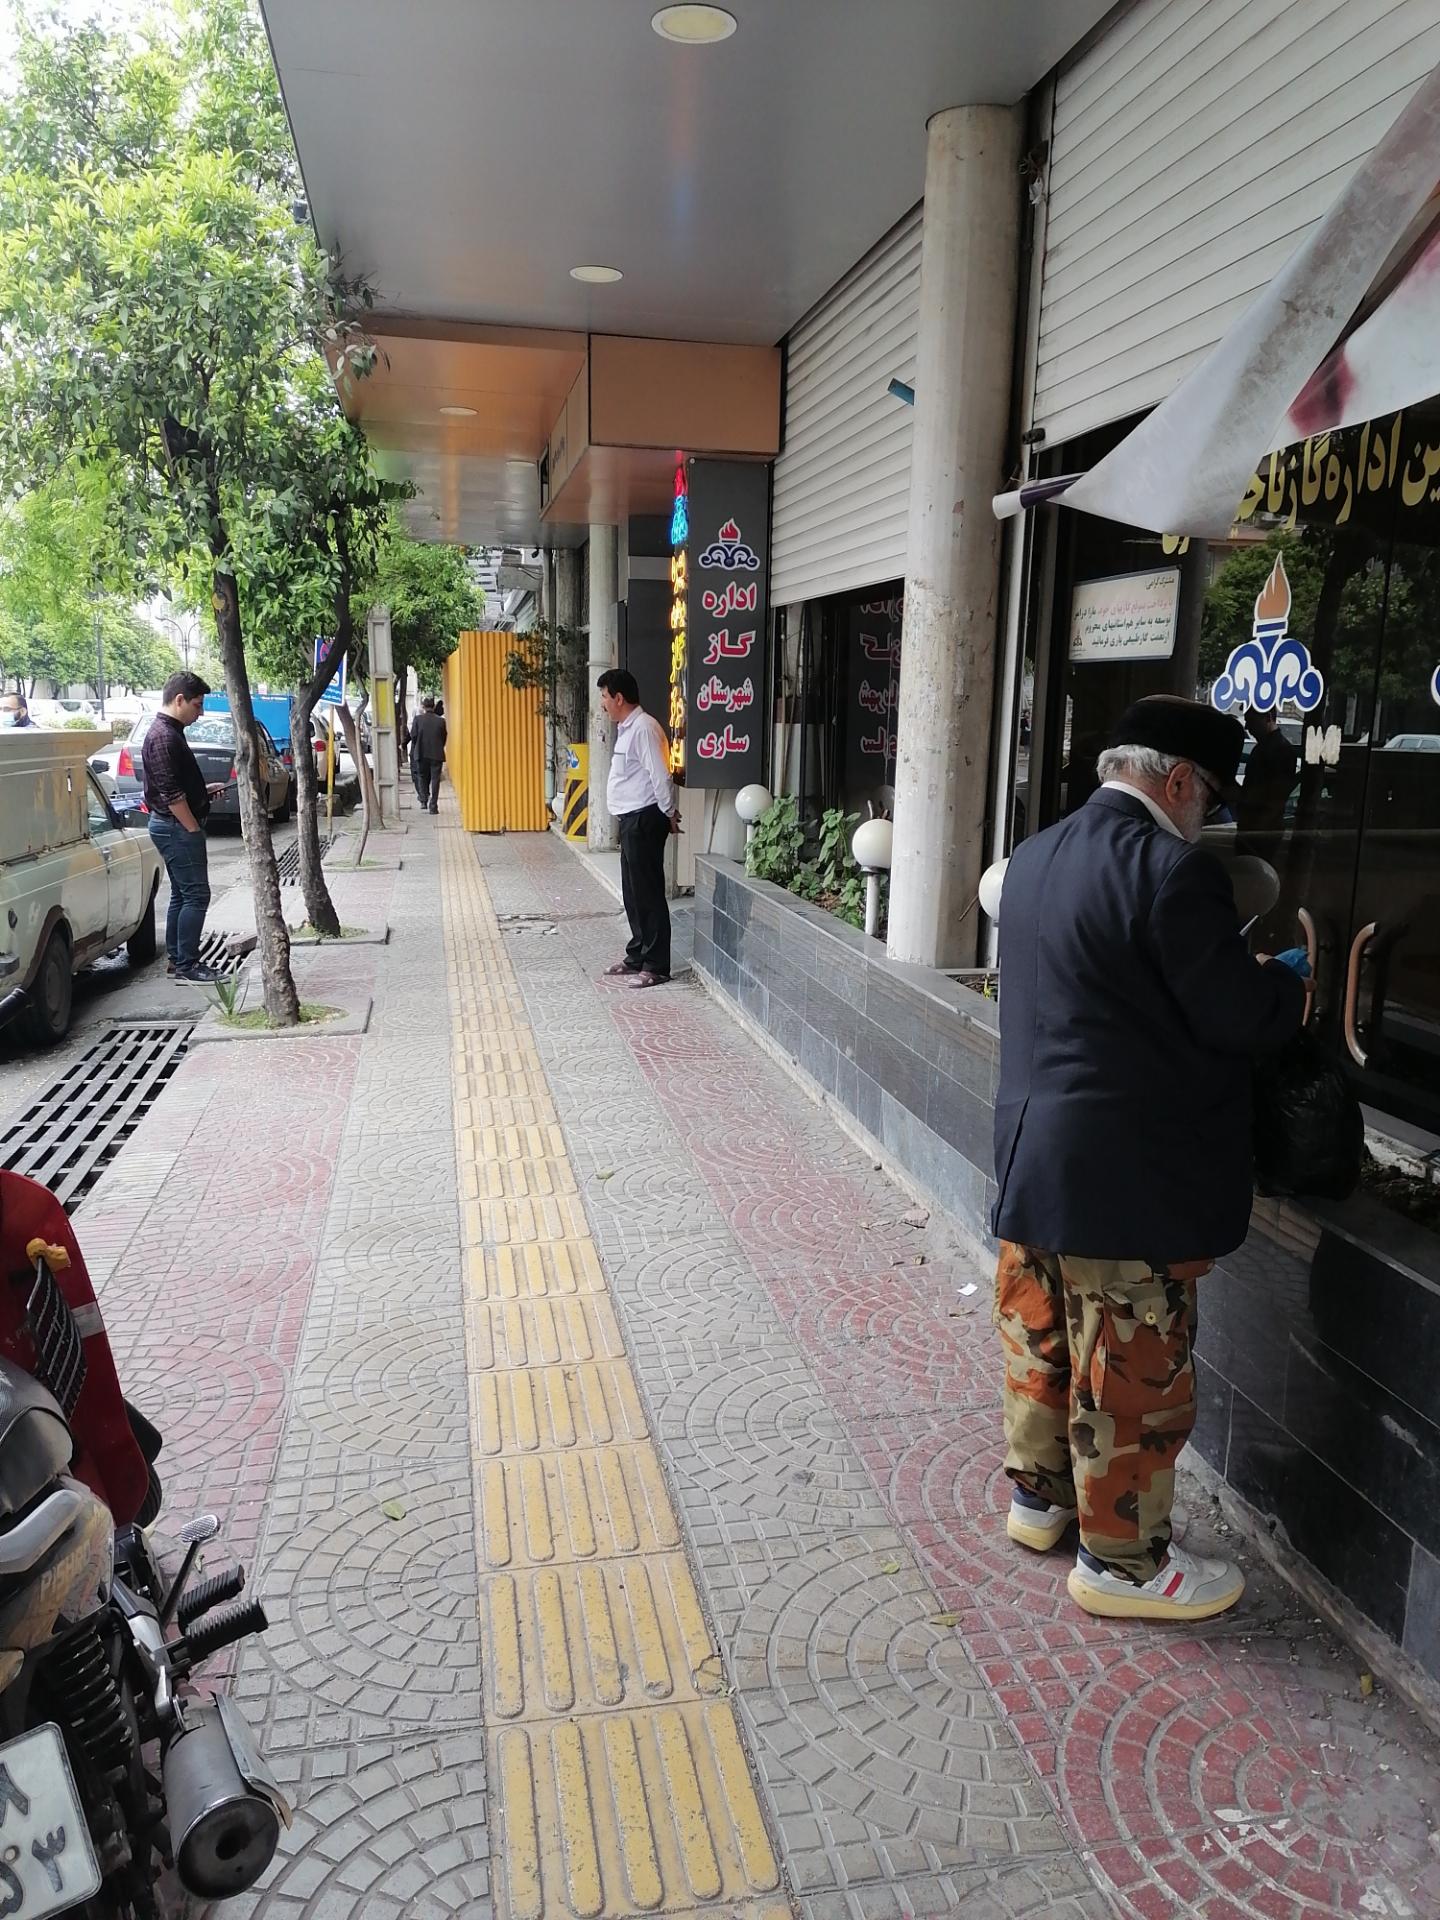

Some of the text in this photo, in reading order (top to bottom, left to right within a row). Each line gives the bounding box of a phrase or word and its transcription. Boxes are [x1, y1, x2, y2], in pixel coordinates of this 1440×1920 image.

[1282, 430, 1331, 535] گاز
[1324, 411, 1403, 526] اداره
[702, 581, 758, 618] اداره
[1146, 578, 1160, 590] گرامی
[1154, 614, 1171, 627] توسعه
[703, 629, 757, 665] گاز
[697, 676, 754, 713] شهرستان
[697, 723, 750, 760] ساری
